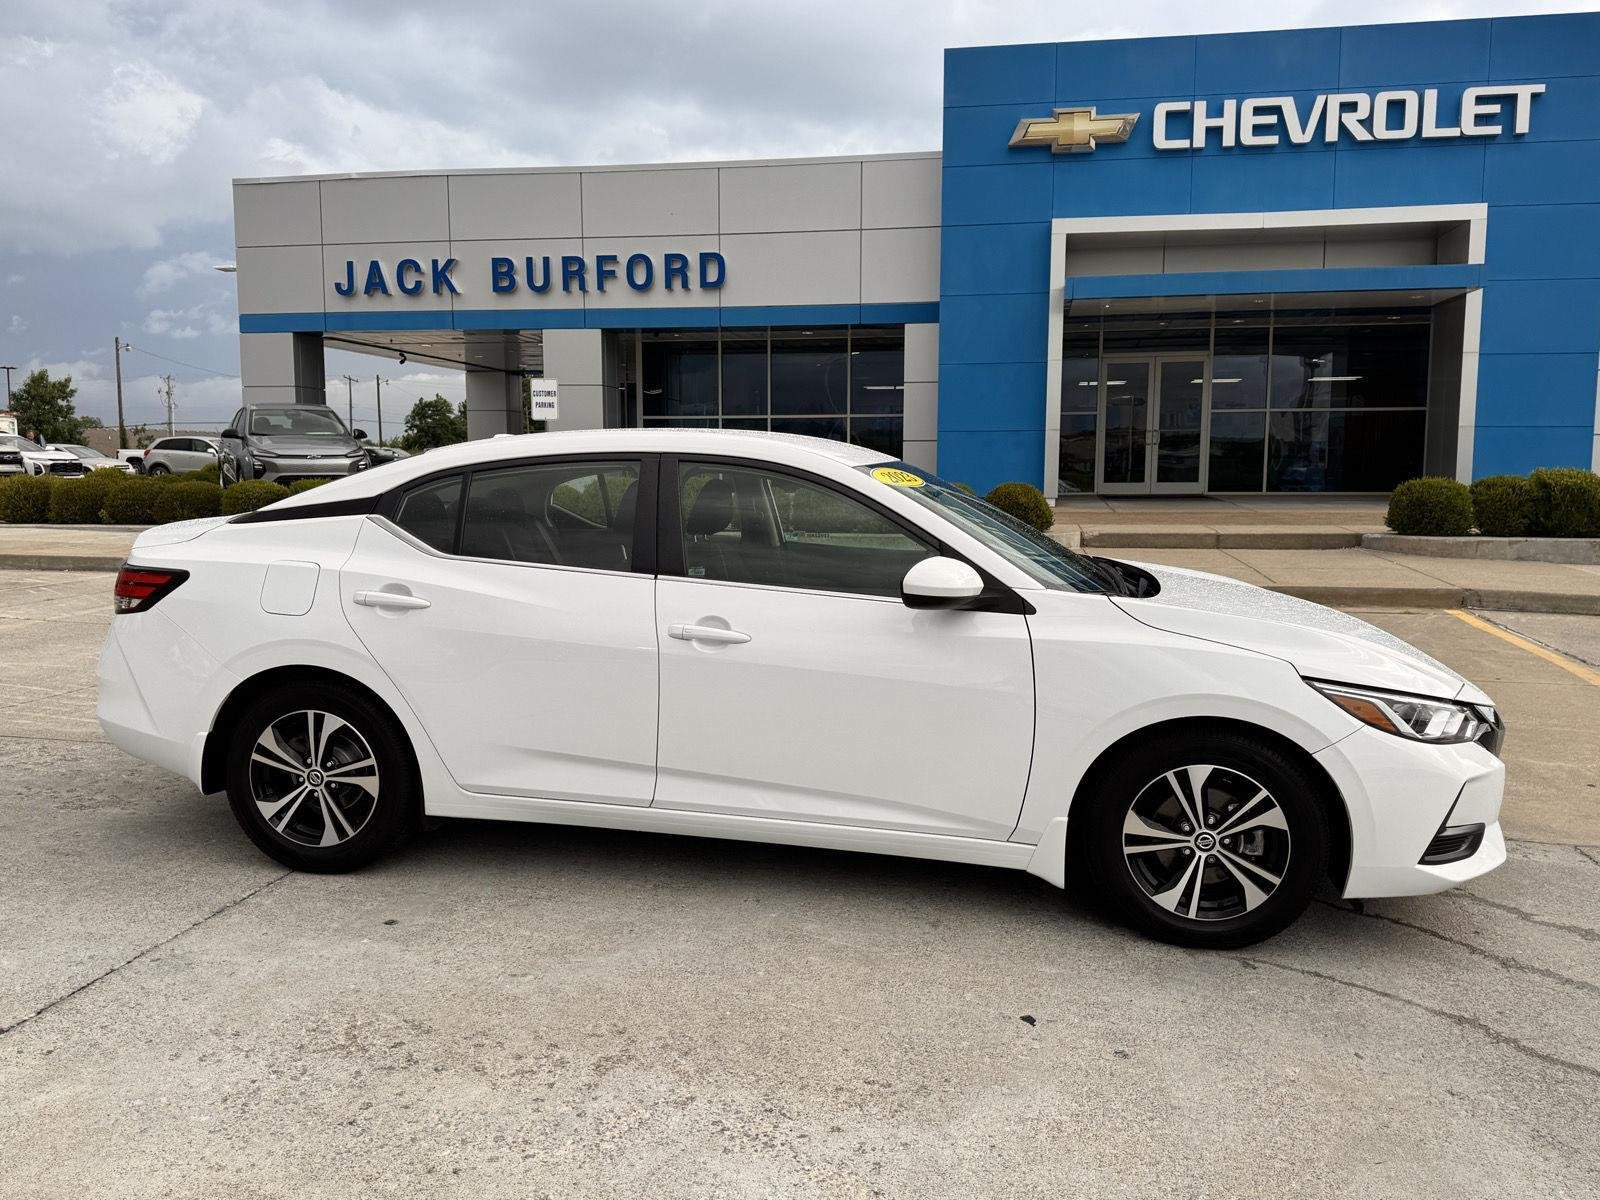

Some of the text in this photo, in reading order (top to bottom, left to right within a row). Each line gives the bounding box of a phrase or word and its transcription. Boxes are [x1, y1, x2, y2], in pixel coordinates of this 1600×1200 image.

[1153, 83, 1546, 149] CHEVROLET
[334, 252, 726, 297] JACK BURFORD
[535, 401, 555, 409] PARKING
